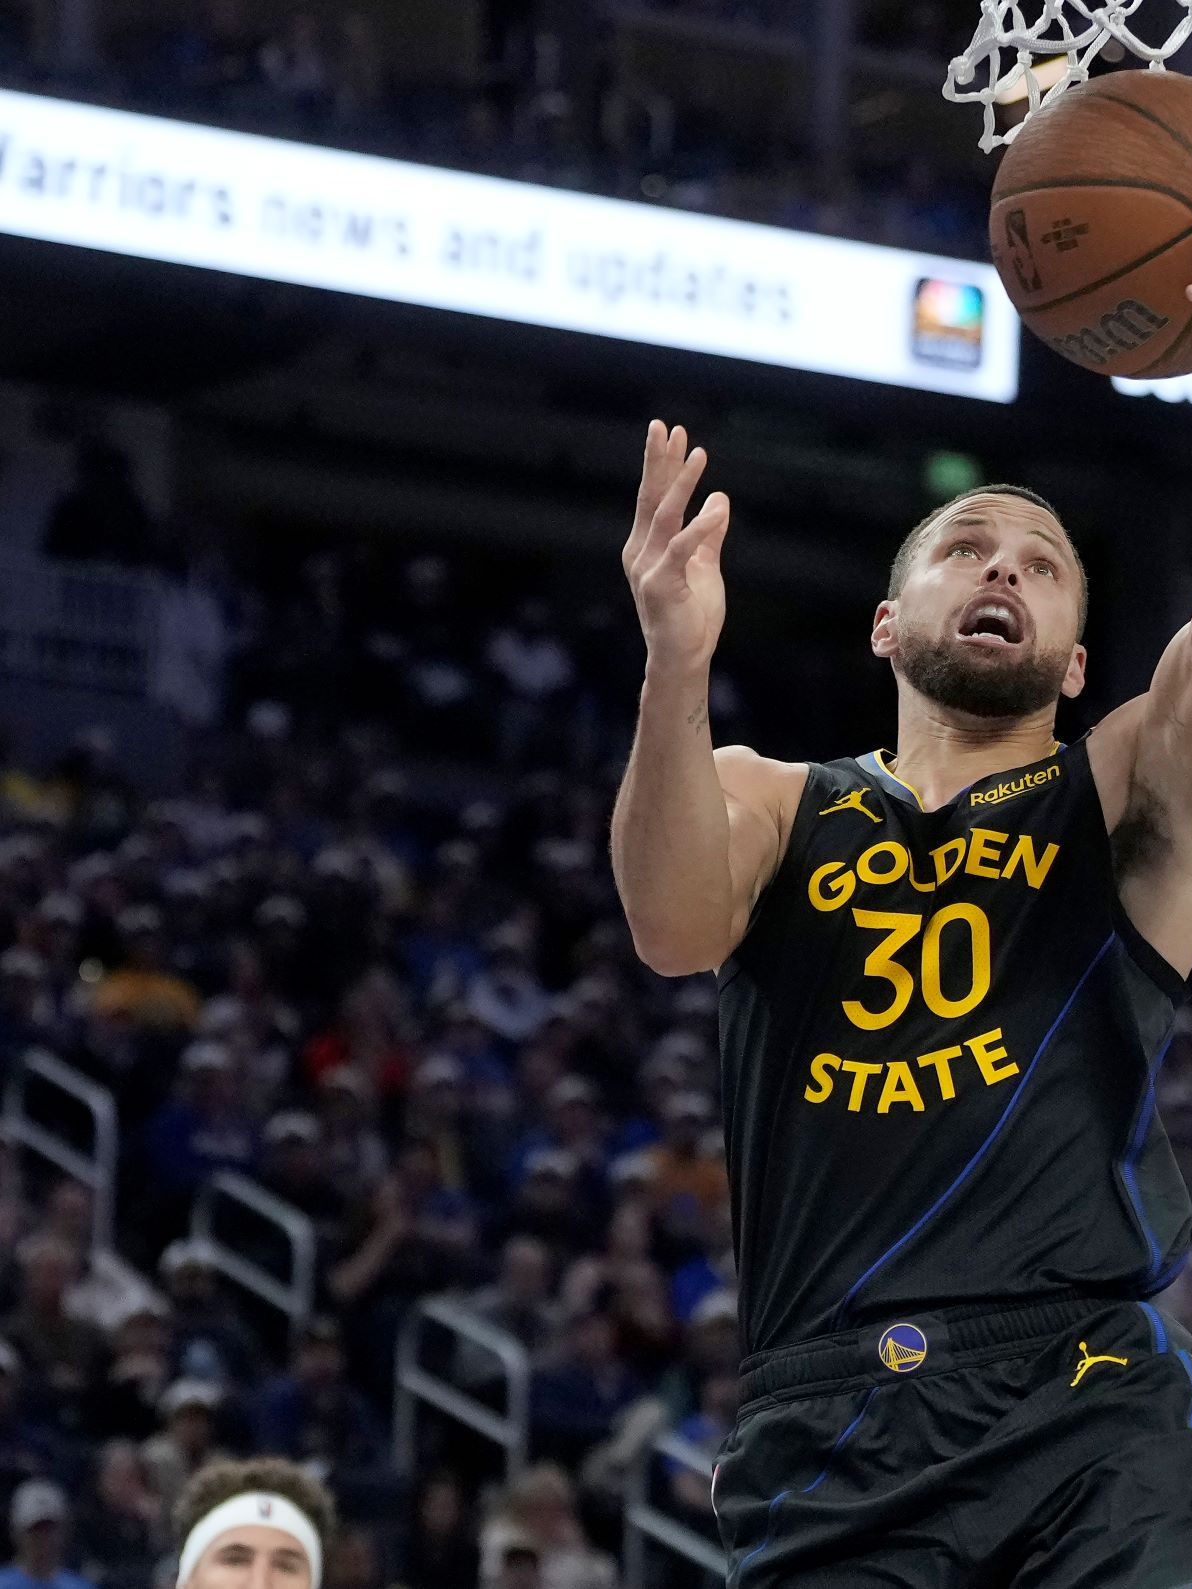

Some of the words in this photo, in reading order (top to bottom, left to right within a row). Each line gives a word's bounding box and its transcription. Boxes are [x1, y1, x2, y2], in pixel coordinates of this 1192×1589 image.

[0, 130, 234, 228] arriors
[259, 192, 412, 258] news
[441, 222, 544, 283] and
[565, 245, 793, 321] updates
[970, 763, 1060, 807] Rakuten
[808, 827, 1060, 912] GOLDEN
[842, 902, 991, 1031] 30
[804, 1027, 1020, 1113] STATE
